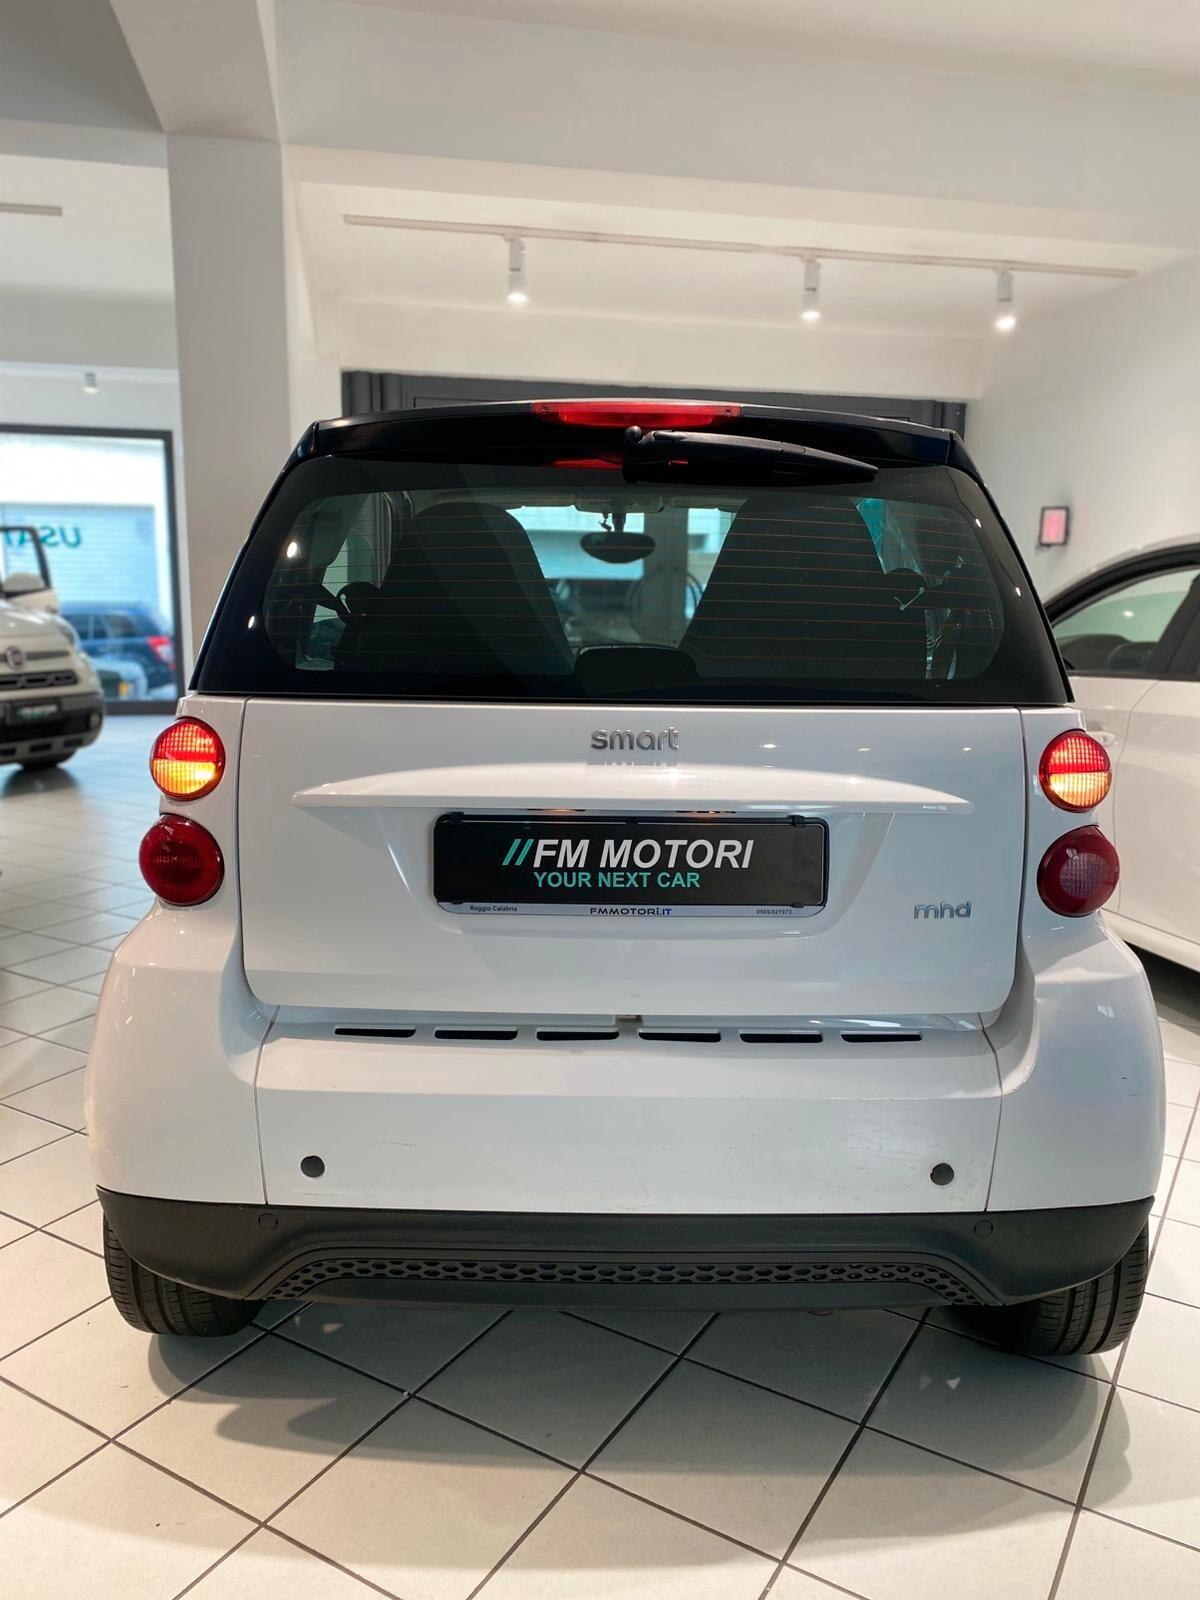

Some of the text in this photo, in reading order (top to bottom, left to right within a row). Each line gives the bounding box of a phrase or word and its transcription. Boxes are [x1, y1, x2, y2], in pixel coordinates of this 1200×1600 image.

[591, 727, 680, 751] smart
[599, 838, 754, 869] MOTORI
[533, 871, 701, 888] YOUR NEXT CAR
[469, 904, 492, 912] Reggio
[913, 900, 972, 920] mhd
